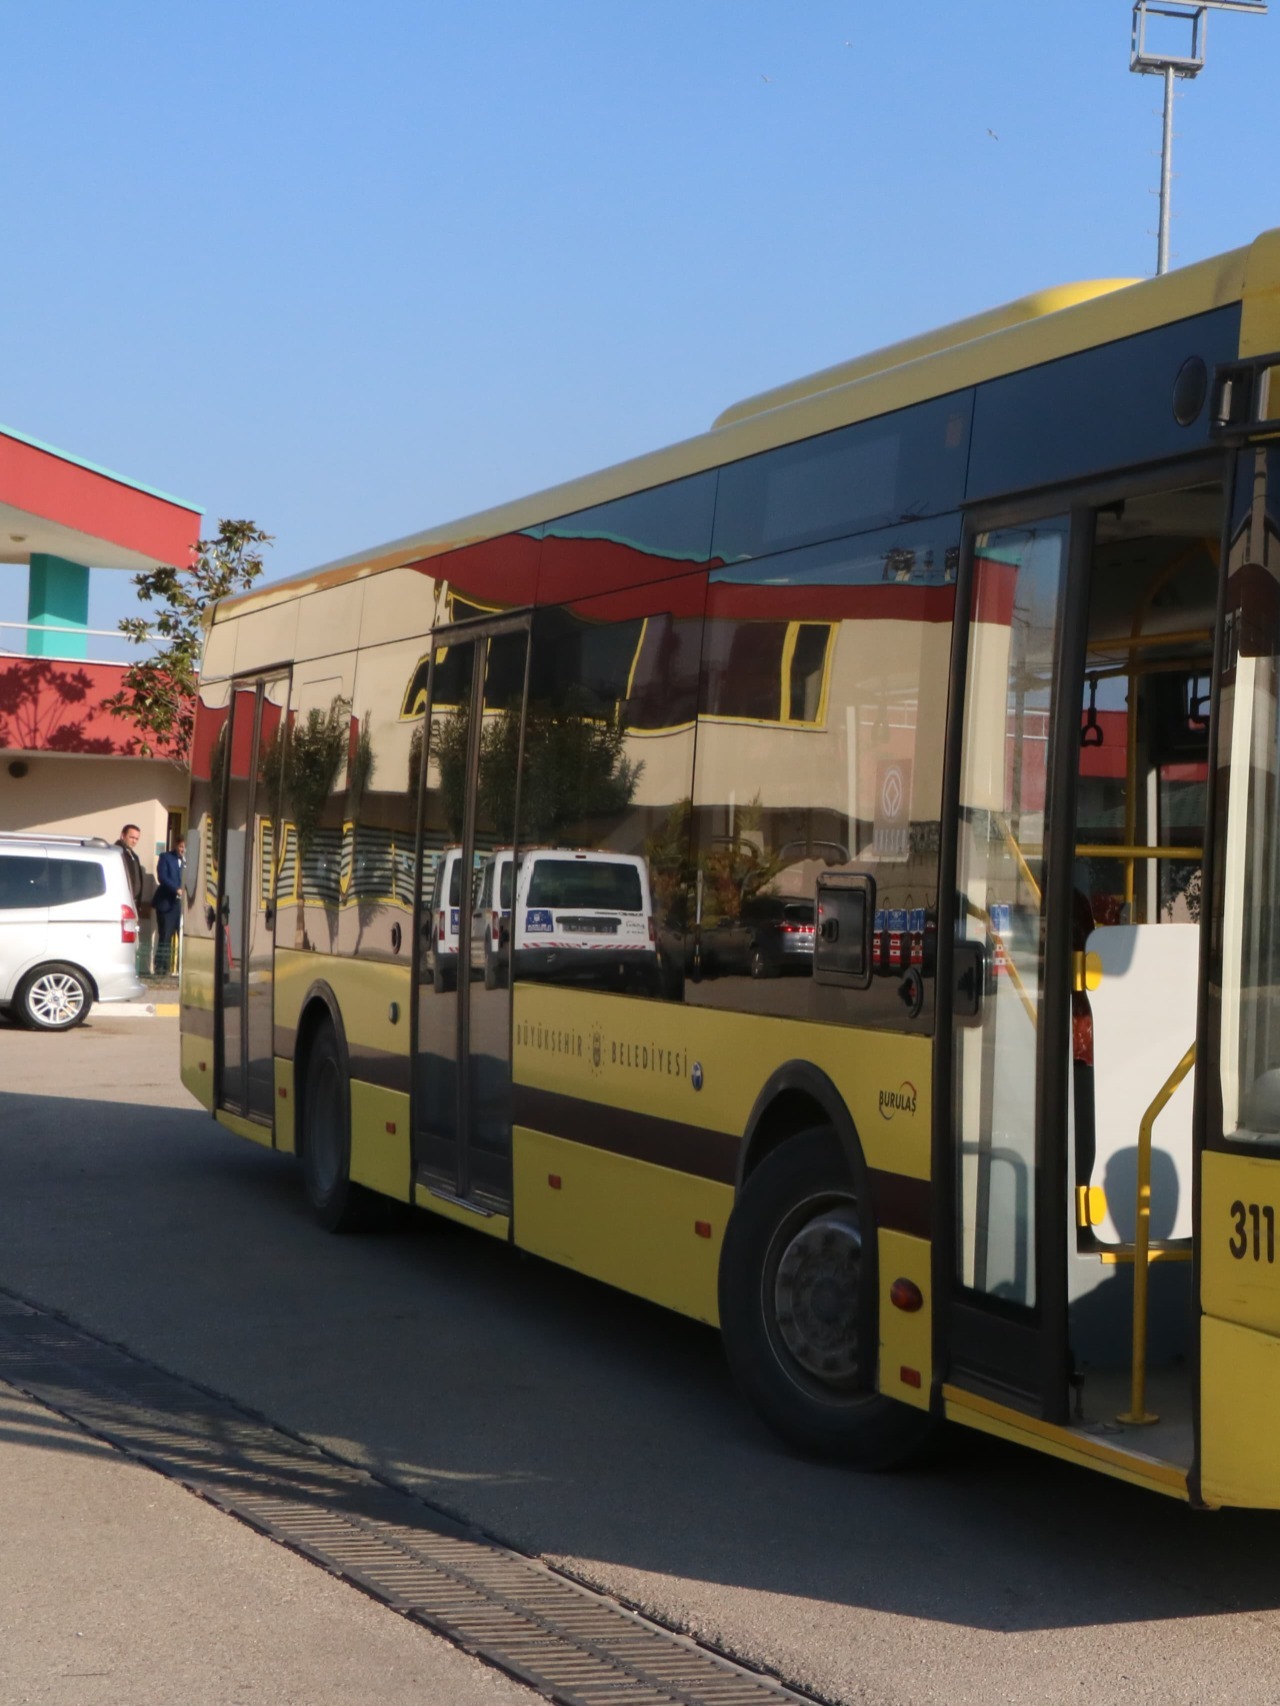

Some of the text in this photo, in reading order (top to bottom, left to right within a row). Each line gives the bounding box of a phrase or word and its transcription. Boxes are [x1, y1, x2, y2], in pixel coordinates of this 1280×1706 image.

[517, 1020, 688, 1078] BÜYÜKŞEHİR BELEDİYESİ
[879, 1090, 916, 1117] BURULAŞ
[1229, 1200, 1275, 1264] 311
